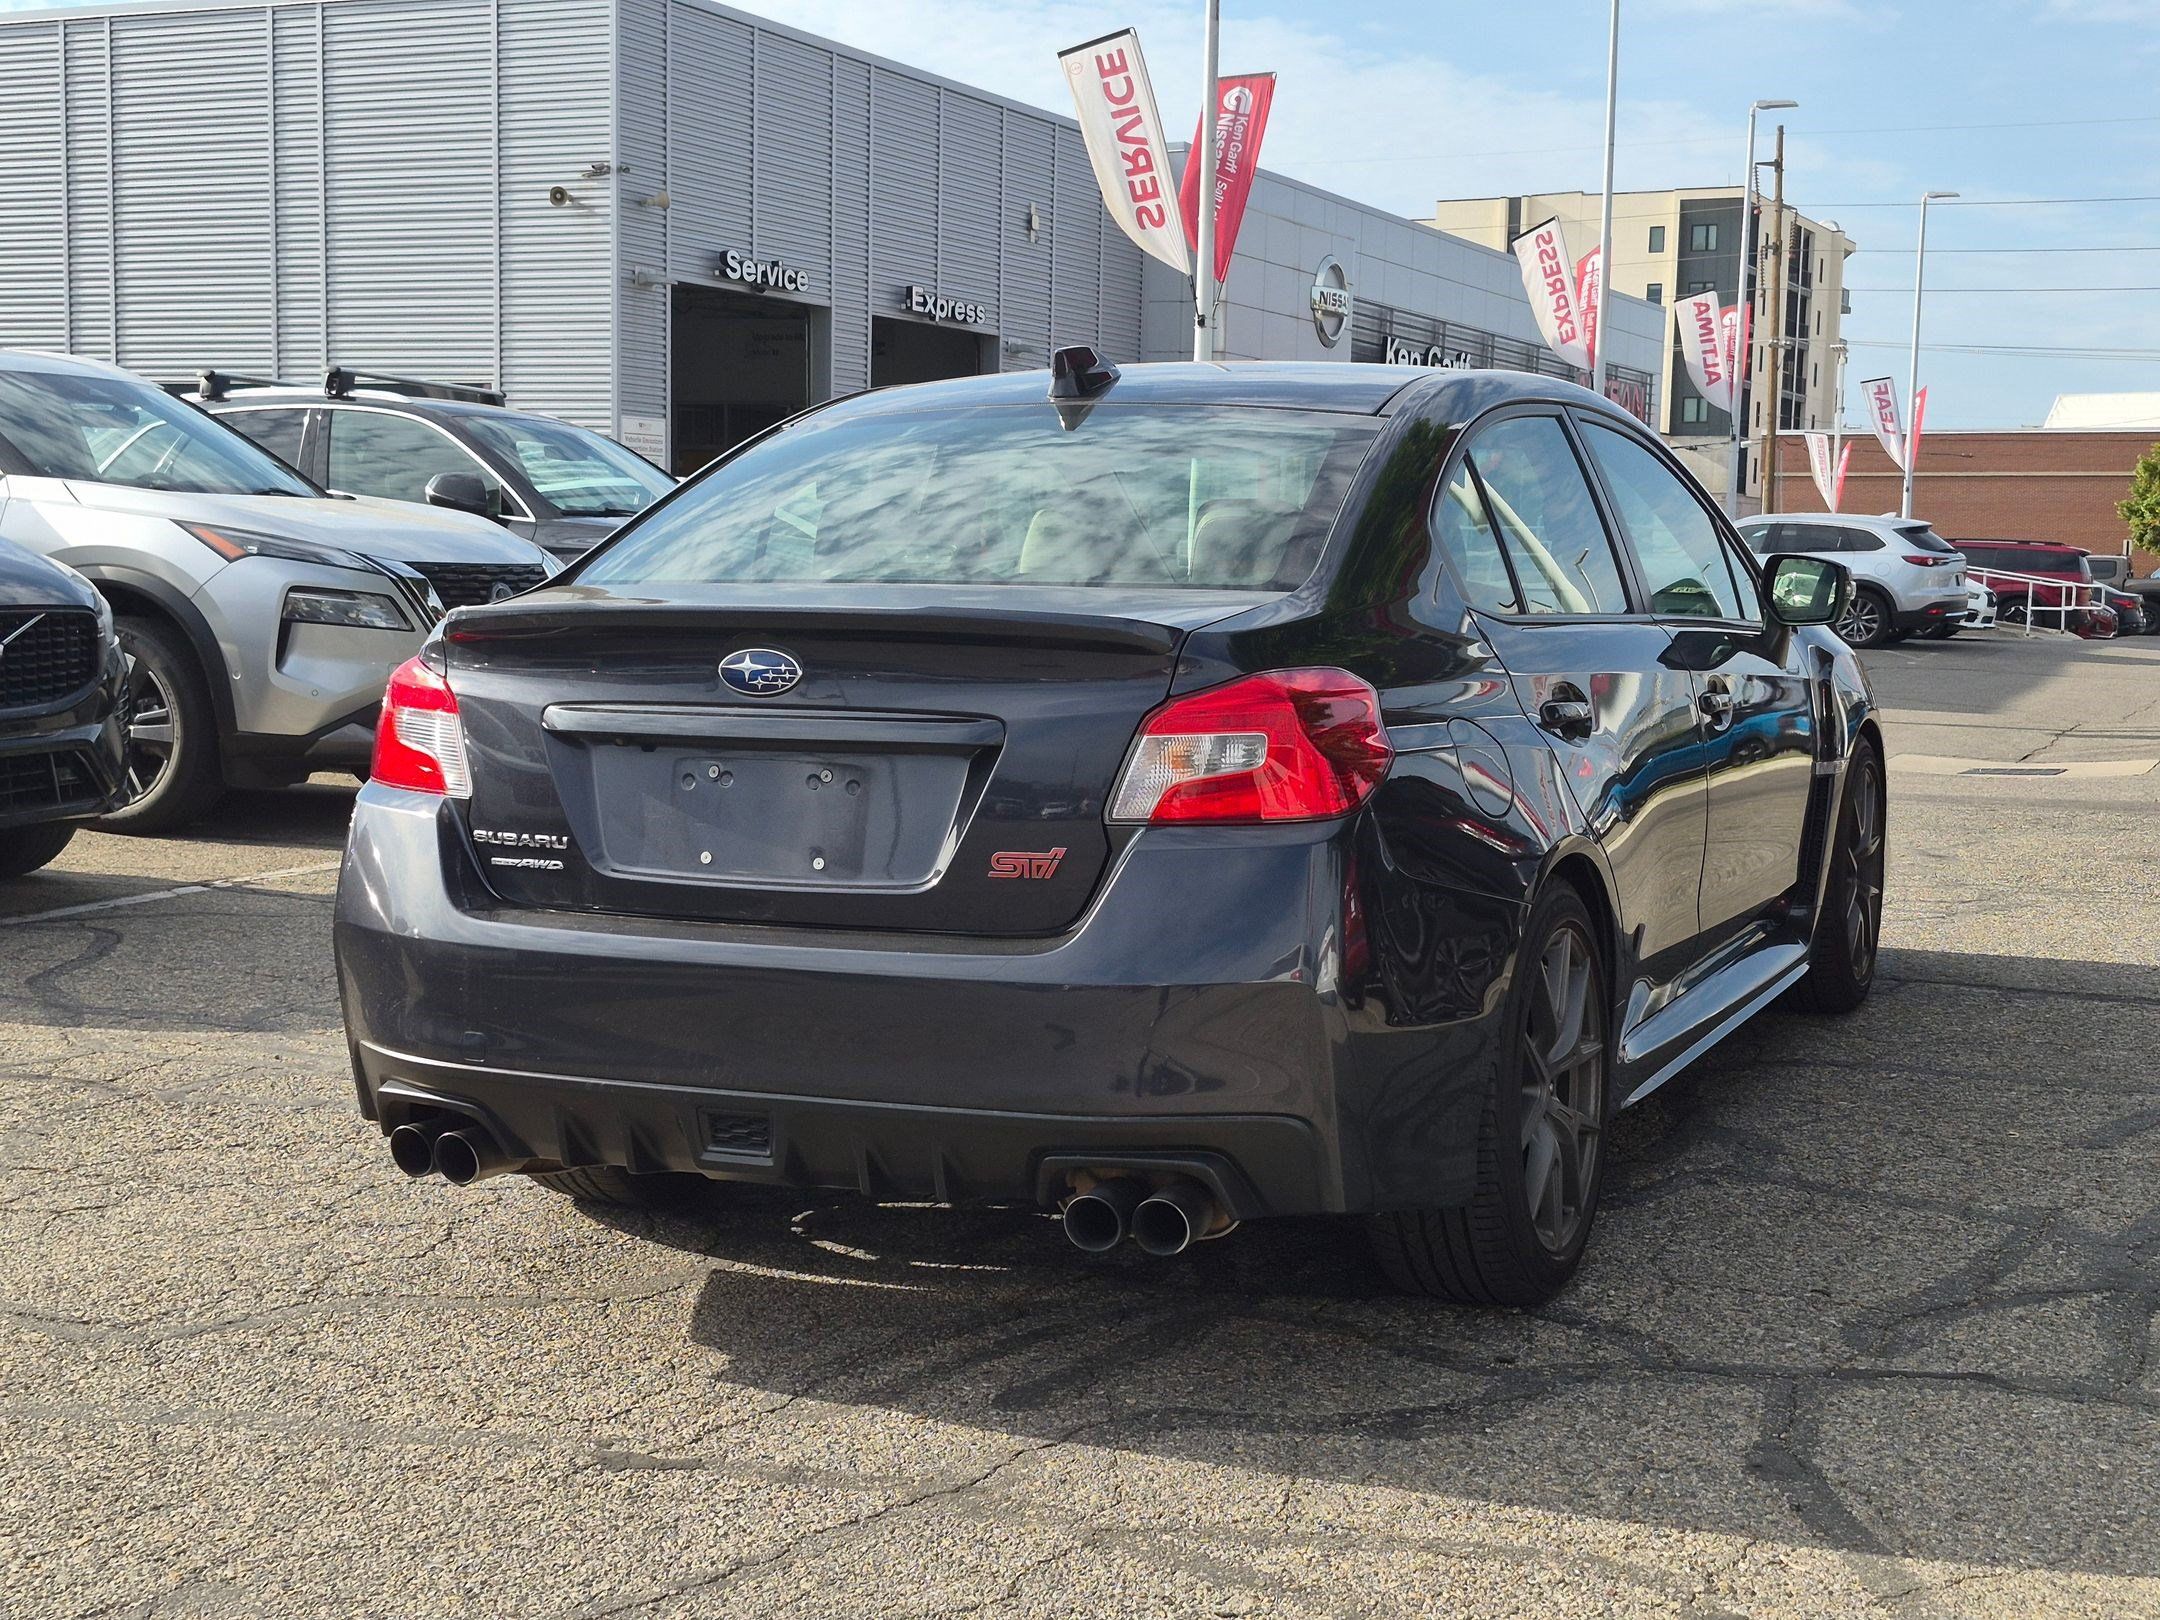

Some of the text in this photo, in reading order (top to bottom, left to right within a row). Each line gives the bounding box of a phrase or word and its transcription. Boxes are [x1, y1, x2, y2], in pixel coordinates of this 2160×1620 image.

[1225, 116, 1249, 174] Ken Garff
[723, 249, 810, 292] Service
[910, 285, 987, 325] Express
[1319, 290, 1349, 309] NISSA
[1385, 335, 1421, 365] Ken
[473, 829, 569, 850] SUBARU
[516, 858, 564, 870] AWD
